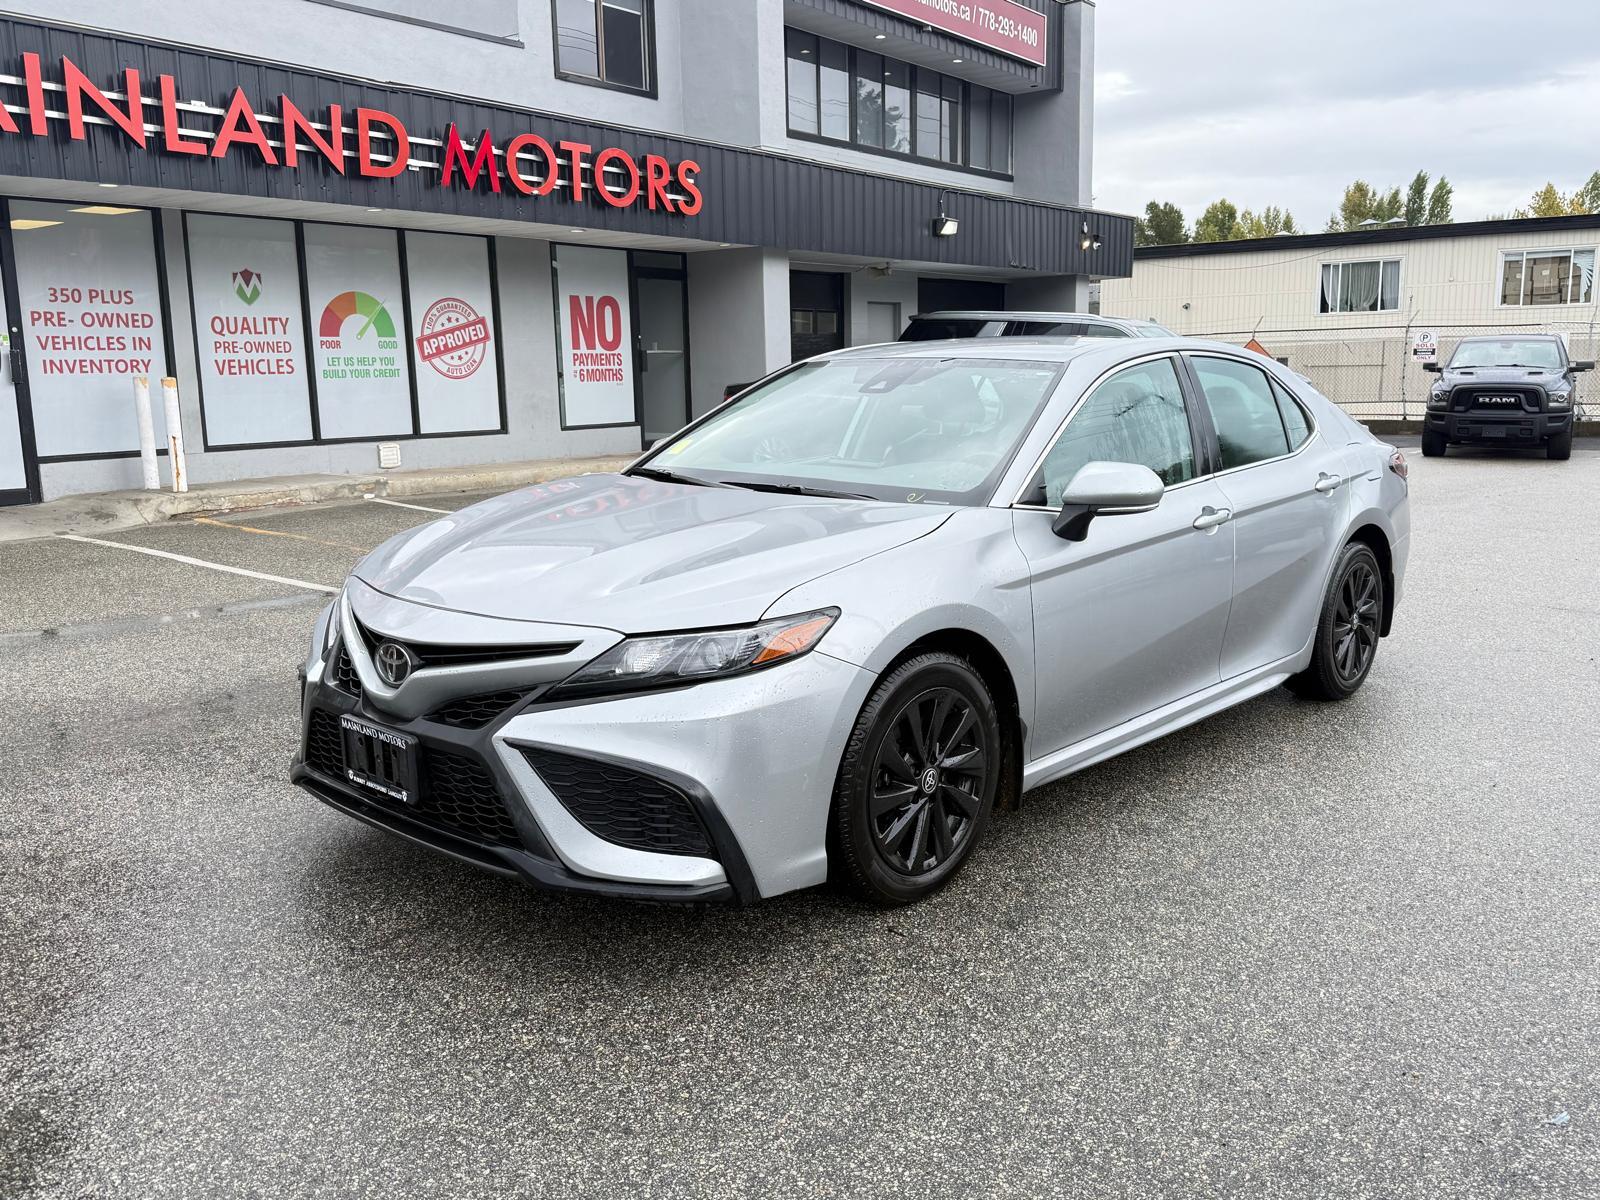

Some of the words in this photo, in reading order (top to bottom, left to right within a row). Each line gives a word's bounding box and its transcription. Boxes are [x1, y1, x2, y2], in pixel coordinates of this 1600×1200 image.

[978, 8, 1038, 47] 778-293-1400
[441, 121, 703, 216] MOTORS
[48, 287, 82, 304] 350
[88, 289, 134, 305] PLUS
[80, 312, 154, 329] OWNED
[426, 312, 437, 330] 100%
[436, 303, 472, 318] GUARANTEED
[569, 294, 622, 352] NO
[210, 315, 290, 337] QUALITY
[36, 335, 127, 351] VEHICLES
[132, 336, 152, 351] IN
[214, 341, 292, 354] PRE-OWNED
[320, 340, 342, 350] POOR
[377, 340, 398, 350] GOOD
[422, 324, 485, 356] APPROVED
[42, 359, 152, 375] INVENTORY
[214, 358, 295, 376] VEHICLES
[327, 356, 341, 367] LET
[343, 356, 355, 367] US
[356, 356, 377, 367] HELP
[379, 356, 395, 367] YOU
[446, 366, 463, 375] AUTO
[463, 358, 478, 373] LOAN
[572, 353, 623, 367] PAYMENTS
[322, 369, 347, 379] BUILD
[348, 369, 371, 379] YOUR
[373, 368, 401, 378] CREDIT
[579, 368, 586, 382] 6
[586, 368, 624, 382] MONTHS
[341, 718, 378, 739] MAINLAND
[378, 732, 406, 750] MOTORS
